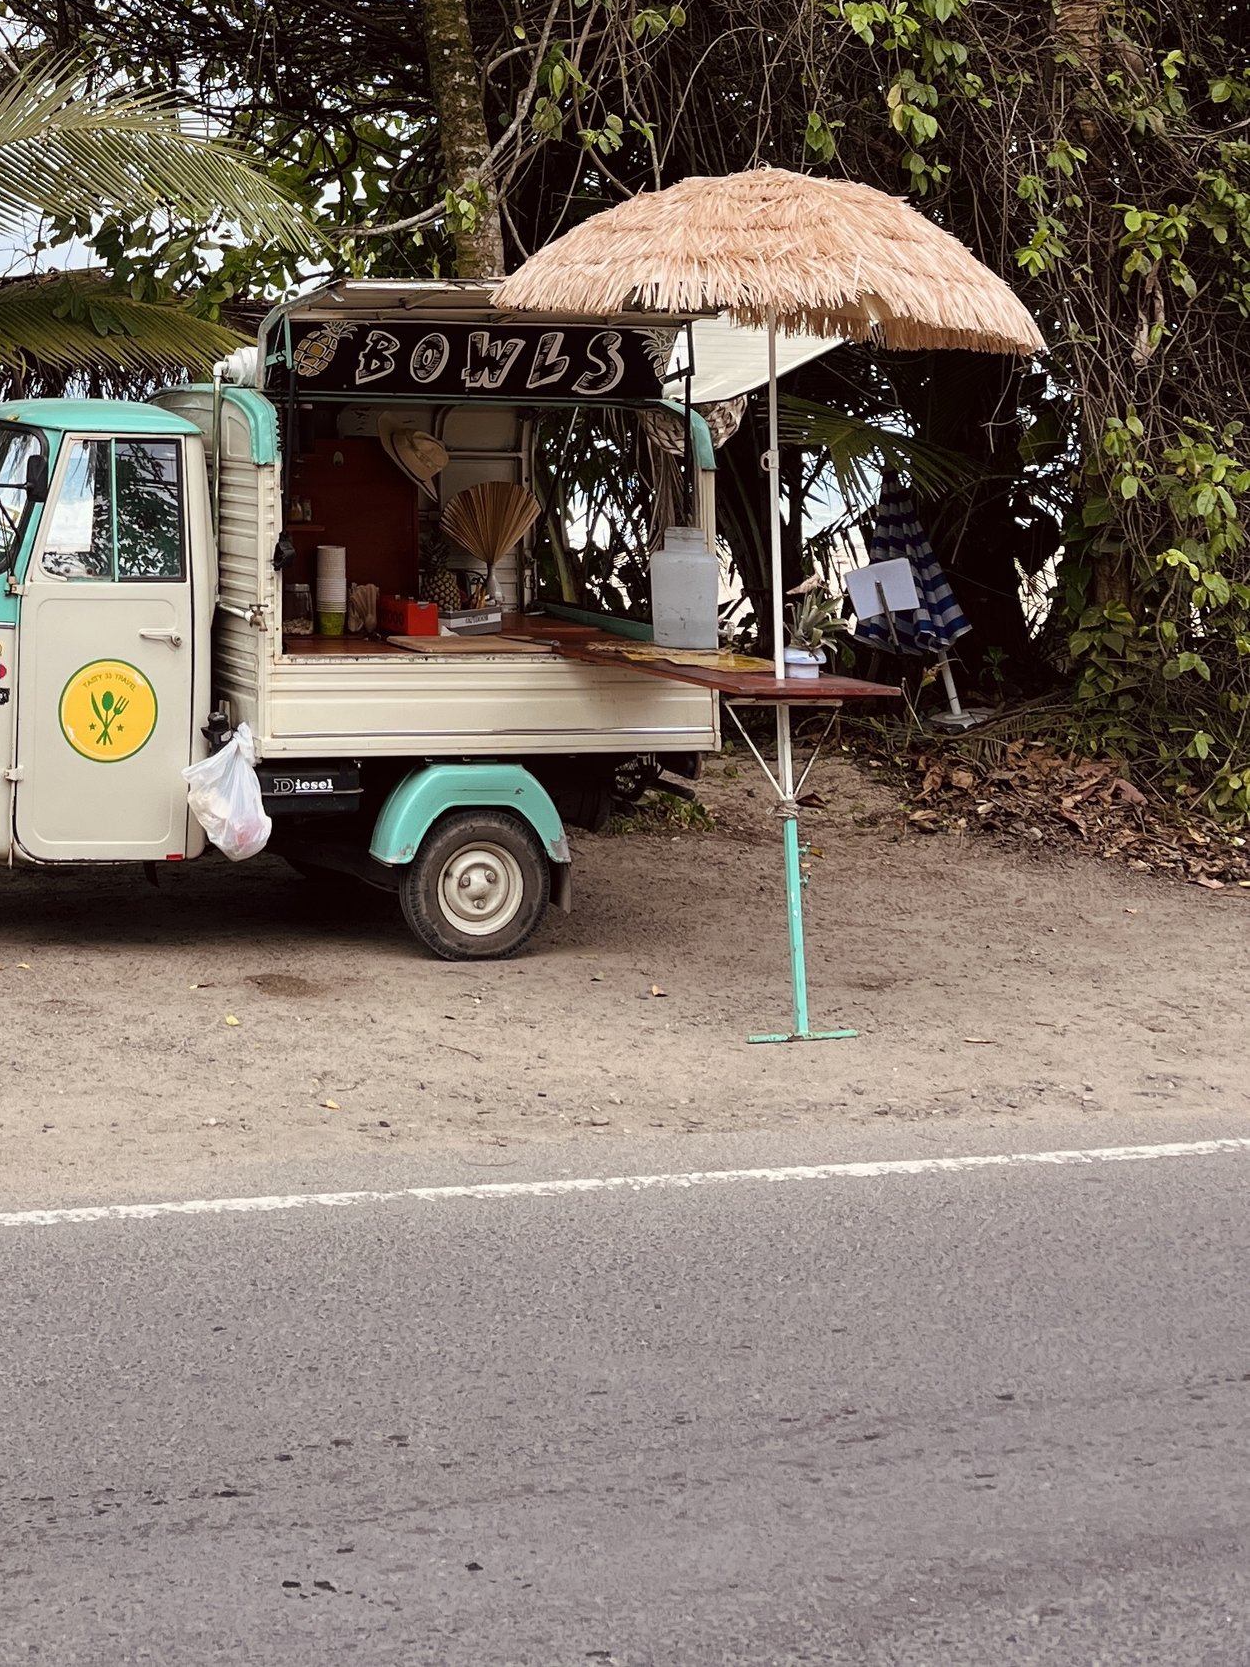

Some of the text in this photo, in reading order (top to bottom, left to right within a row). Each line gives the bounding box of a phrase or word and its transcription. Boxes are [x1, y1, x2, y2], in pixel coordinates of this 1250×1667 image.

[355, 330, 625, 395] BOWLS
[82, 674, 102, 688] TASTY
[115, 673, 136, 692] TRAVEL
[273, 778, 334, 794] Diesel
